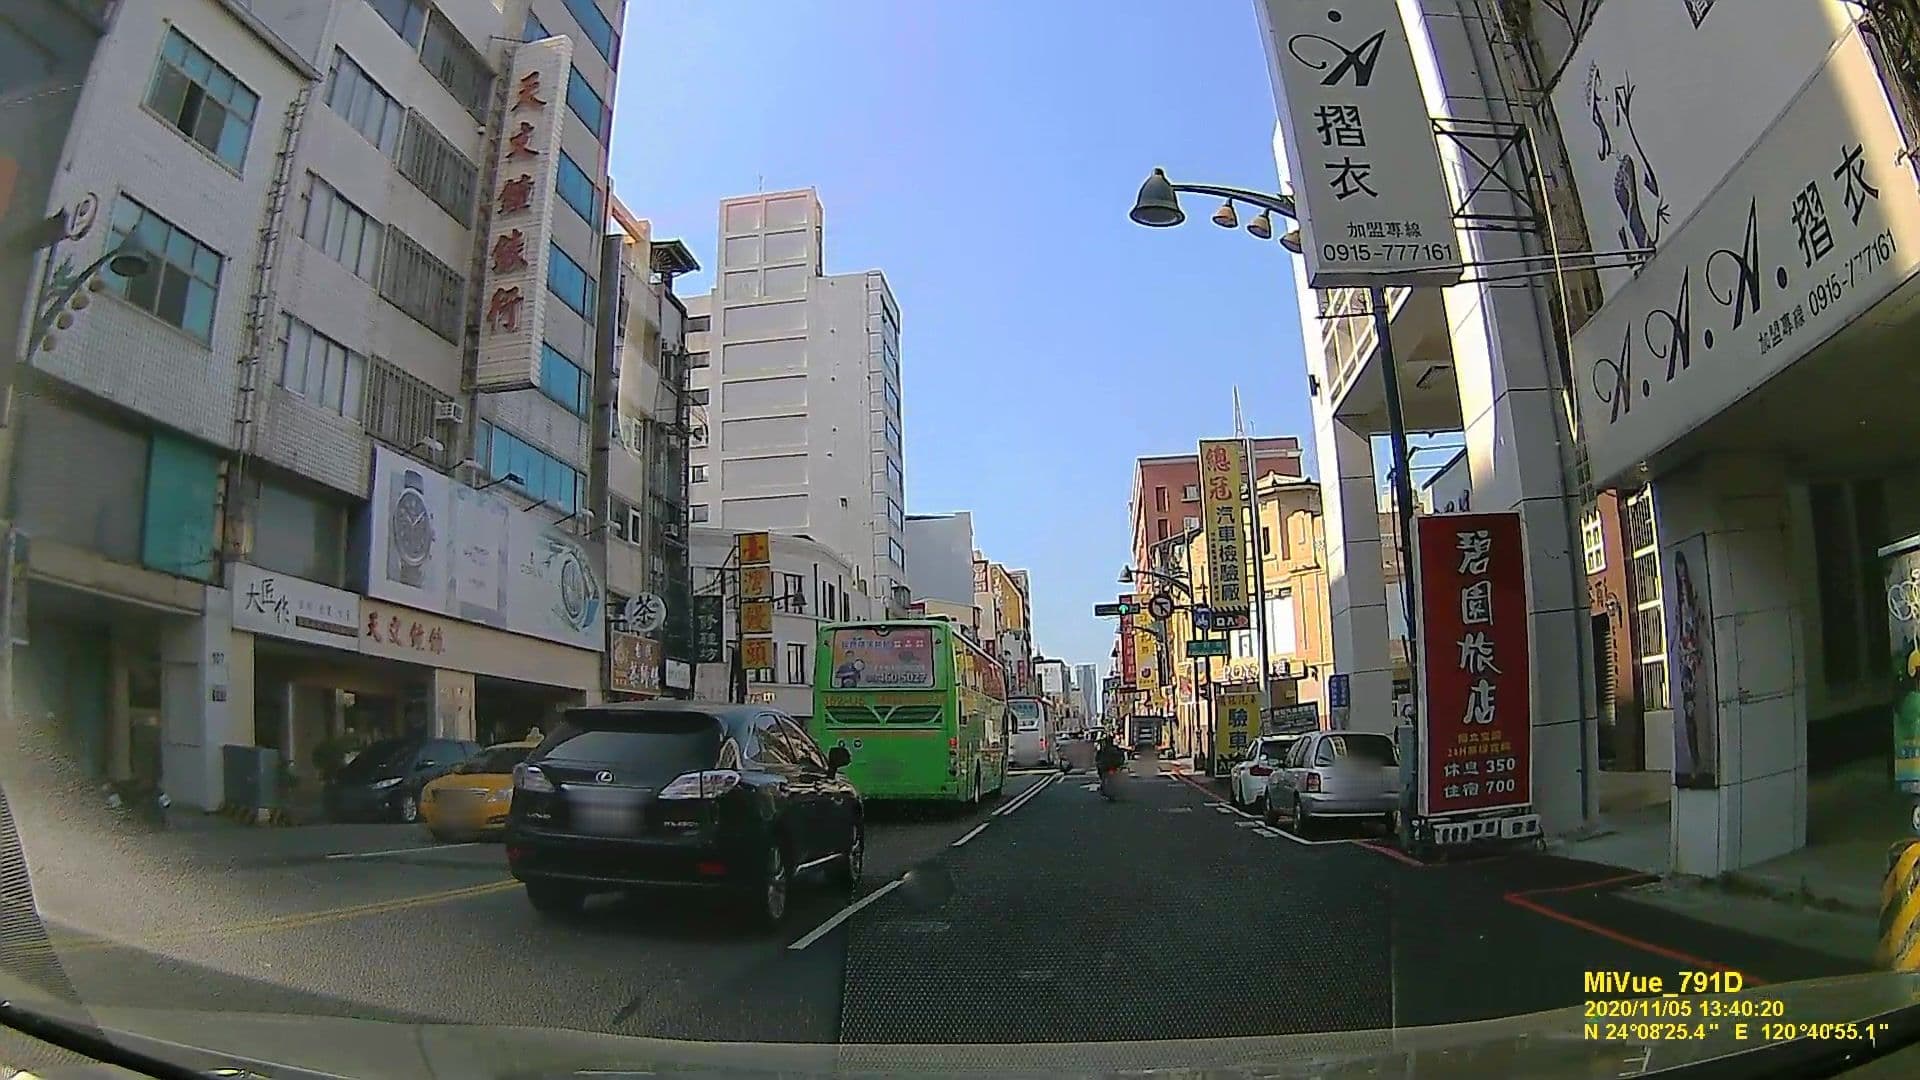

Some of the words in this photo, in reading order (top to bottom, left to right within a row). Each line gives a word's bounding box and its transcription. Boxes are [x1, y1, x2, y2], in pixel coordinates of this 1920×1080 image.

[1347, 221, 1423, 239] 加盟專線
[1323, 244, 1452, 263] 0915-777161
[1808, 227, 1898, 318] 0915-777161
[633, 595, 657, 624] 茶
[1443, 761, 1480, 777] 休息
[1485, 757, 1516, 773] 350
[1443, 781, 1480, 798] 住宿
[1485, 779, 1516, 795] 700
